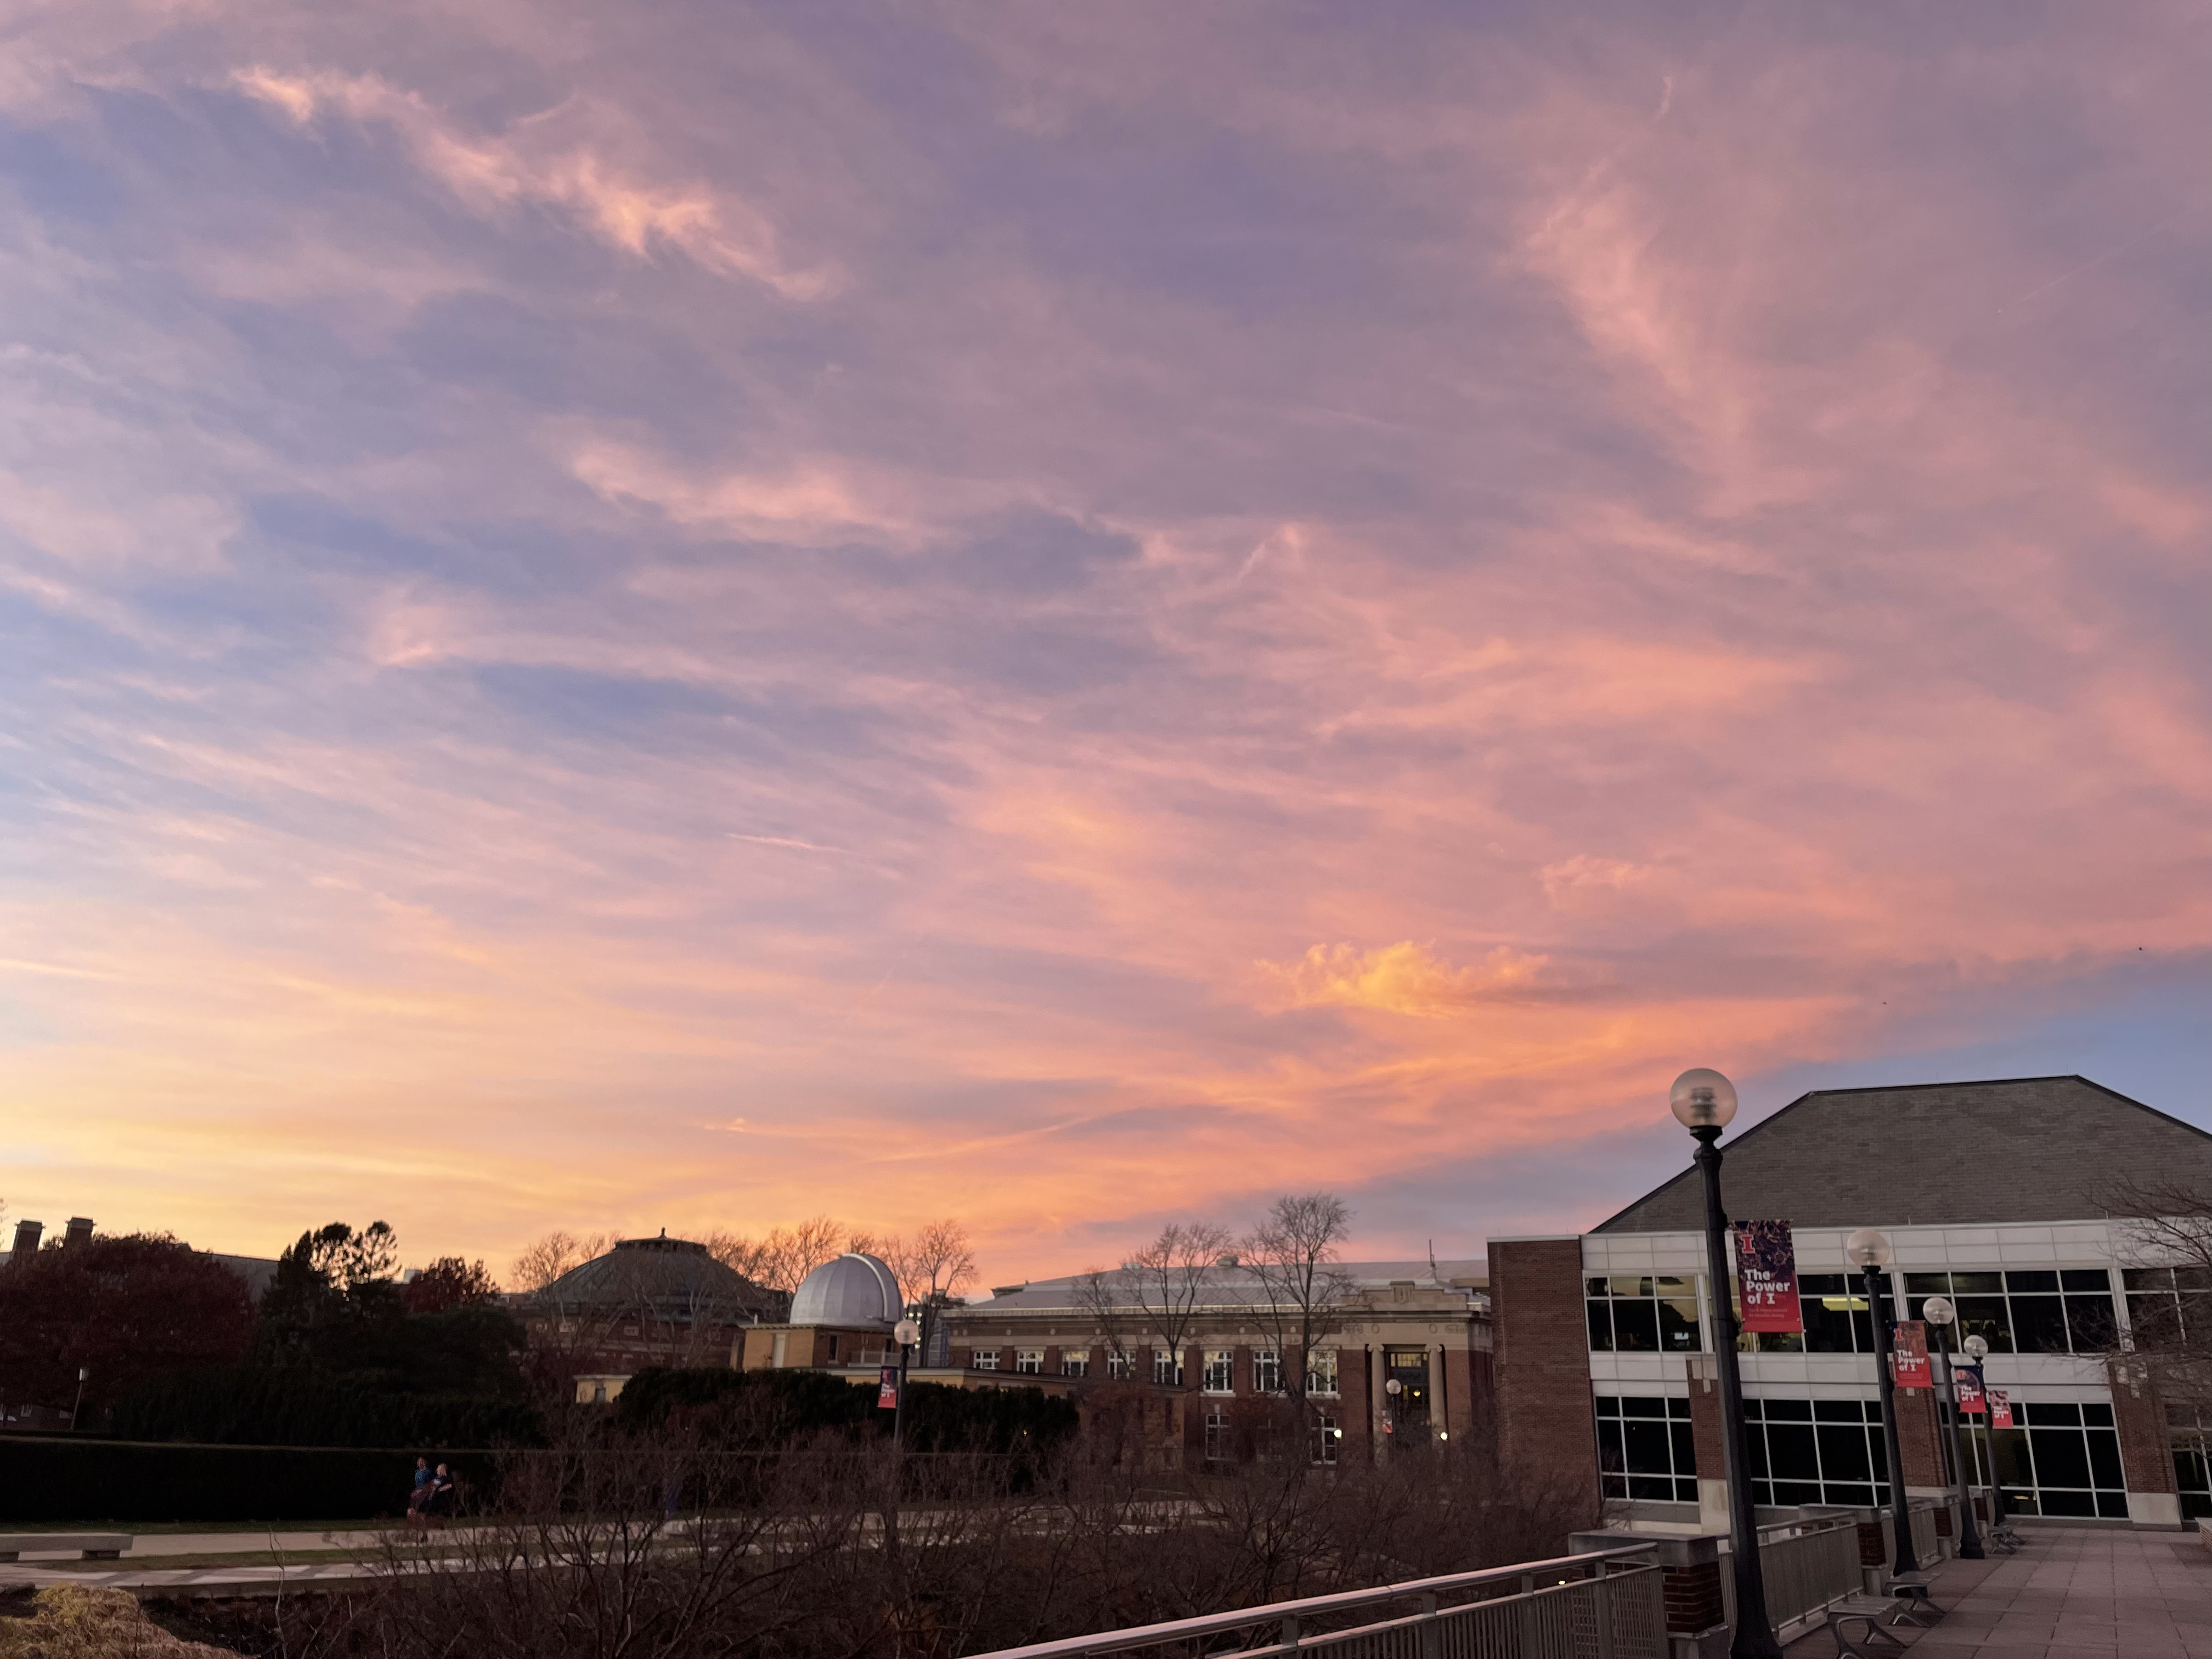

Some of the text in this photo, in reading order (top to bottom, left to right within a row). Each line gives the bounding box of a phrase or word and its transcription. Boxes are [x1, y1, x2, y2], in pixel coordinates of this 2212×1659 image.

[1741, 1234, 1756, 1254] I
[1744, 1268, 1770, 1281] The
[1746, 1281, 1790, 1293] Power
[1747, 1292, 1776, 1305] of I
[1910, 1364, 1916, 1372] I
